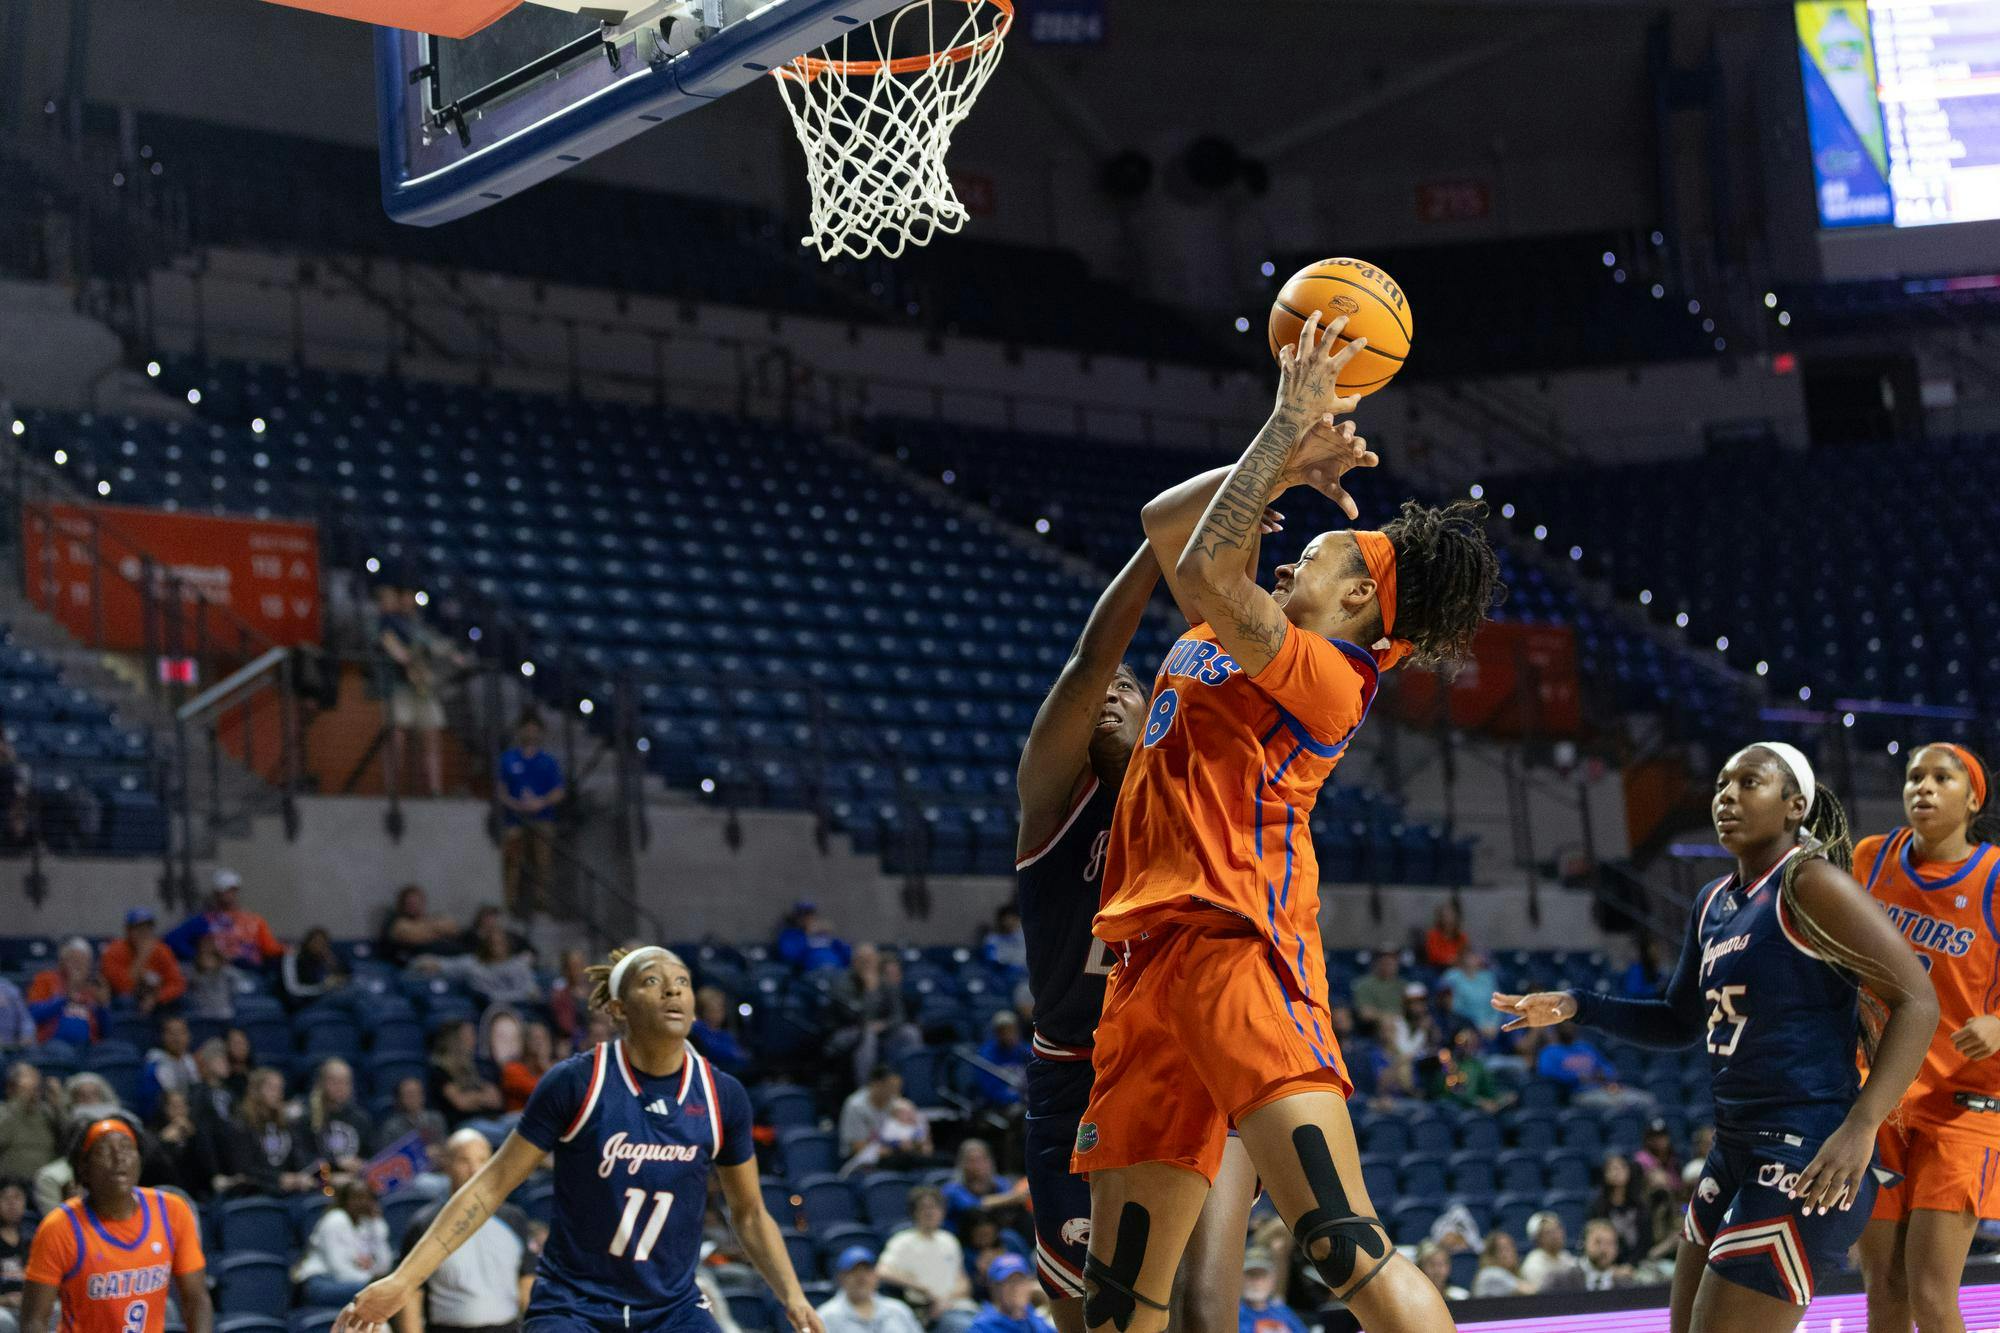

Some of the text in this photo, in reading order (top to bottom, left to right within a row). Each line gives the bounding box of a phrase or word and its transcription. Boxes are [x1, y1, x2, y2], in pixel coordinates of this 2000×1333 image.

[1157, 638, 1242, 686] TORS
[1143, 687, 1179, 748] 8
[1879, 902, 1976, 958] ATORS
[1705, 984, 1749, 1057] 25
[597, 1131, 699, 1179] Jaguars
[608, 1187, 675, 1261] 11
[122, 1299, 149, 1333] 9
